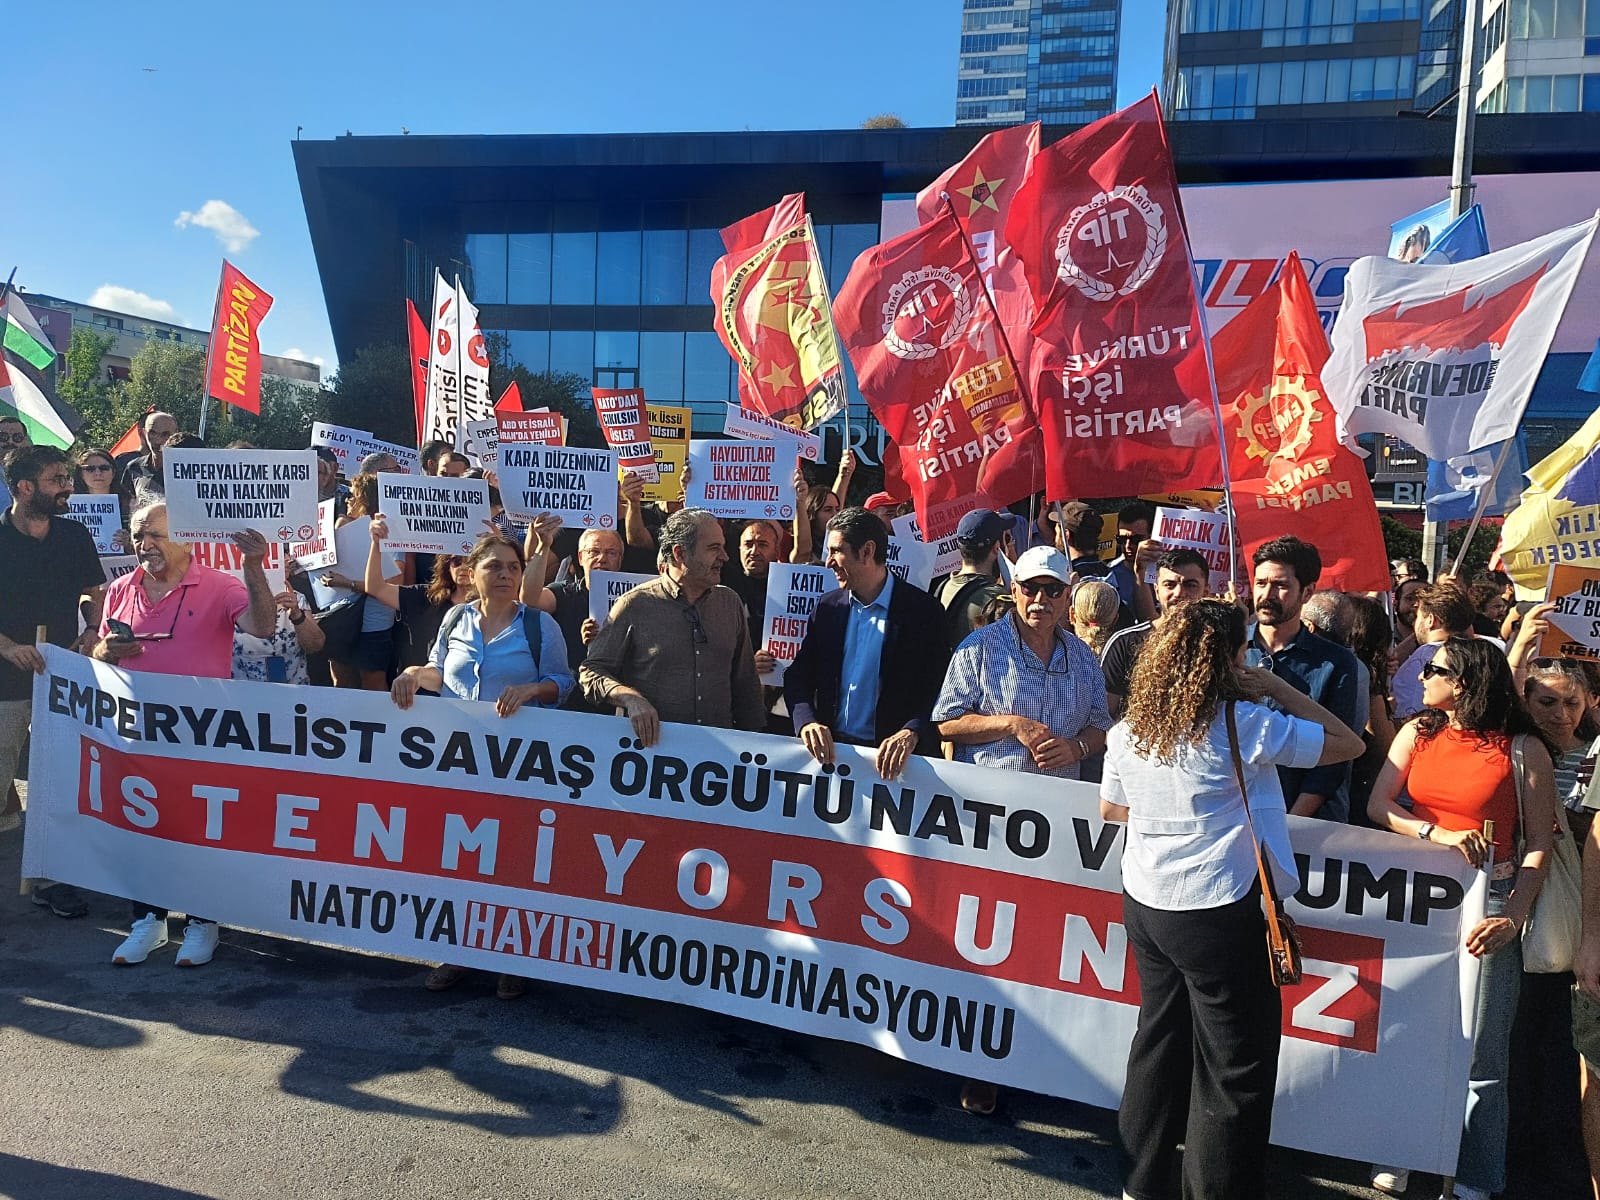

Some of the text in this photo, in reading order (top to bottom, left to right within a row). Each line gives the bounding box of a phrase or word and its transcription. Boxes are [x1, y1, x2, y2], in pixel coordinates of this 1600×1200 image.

[223, 280, 257, 397] PARTİZAN
[519, 421, 528, 429] VE
[529, 417, 556, 429] İSRAİL
[530, 427, 561, 440] YENİLDİ
[609, 427, 636, 442] ÜSLER
[504, 449, 611, 473] KARA DÜZENİNİZİ
[710, 445, 776, 463] HAYDUTLARI
[173, 462, 269, 481] EMPERYALİZME
[528, 470, 586, 491] BAŞINIZA
[713, 463, 771, 482] ÜLKEMİZDE
[196, 481, 290, 500] İRAN HALKININ
[384, 485, 451, 503] EMPERYALİZME
[704, 482, 779, 502] İSTEMİYORUZ!
[205, 502, 285, 519] YANINDAYIZ!
[399, 500, 469, 520] İRAN HALKININ
[522, 491, 593, 511] YIKACAĞIZ!
[174, 530, 208, 539] TÜRKİYE
[209, 530, 225, 540] İŞÇİ
[405, 518, 466, 535] YANINDAYIZ!
[1158, 514, 1215, 545] İNCİRLİK
[790, 571, 825, 593] KATİL
[771, 615, 807, 638] FİLİST
[48, 674, 387, 764] EMPERYALİST
[399, 725, 596, 800] SAVAŞ
[609, 736, 855, 825] ÖRGÜTÜ
[868, 783, 1051, 859] NATO
[1072, 817, 1127, 875] V
[289, 879, 1015, 1060] NATO'YA HAYIR! KOORDİNASYONU
